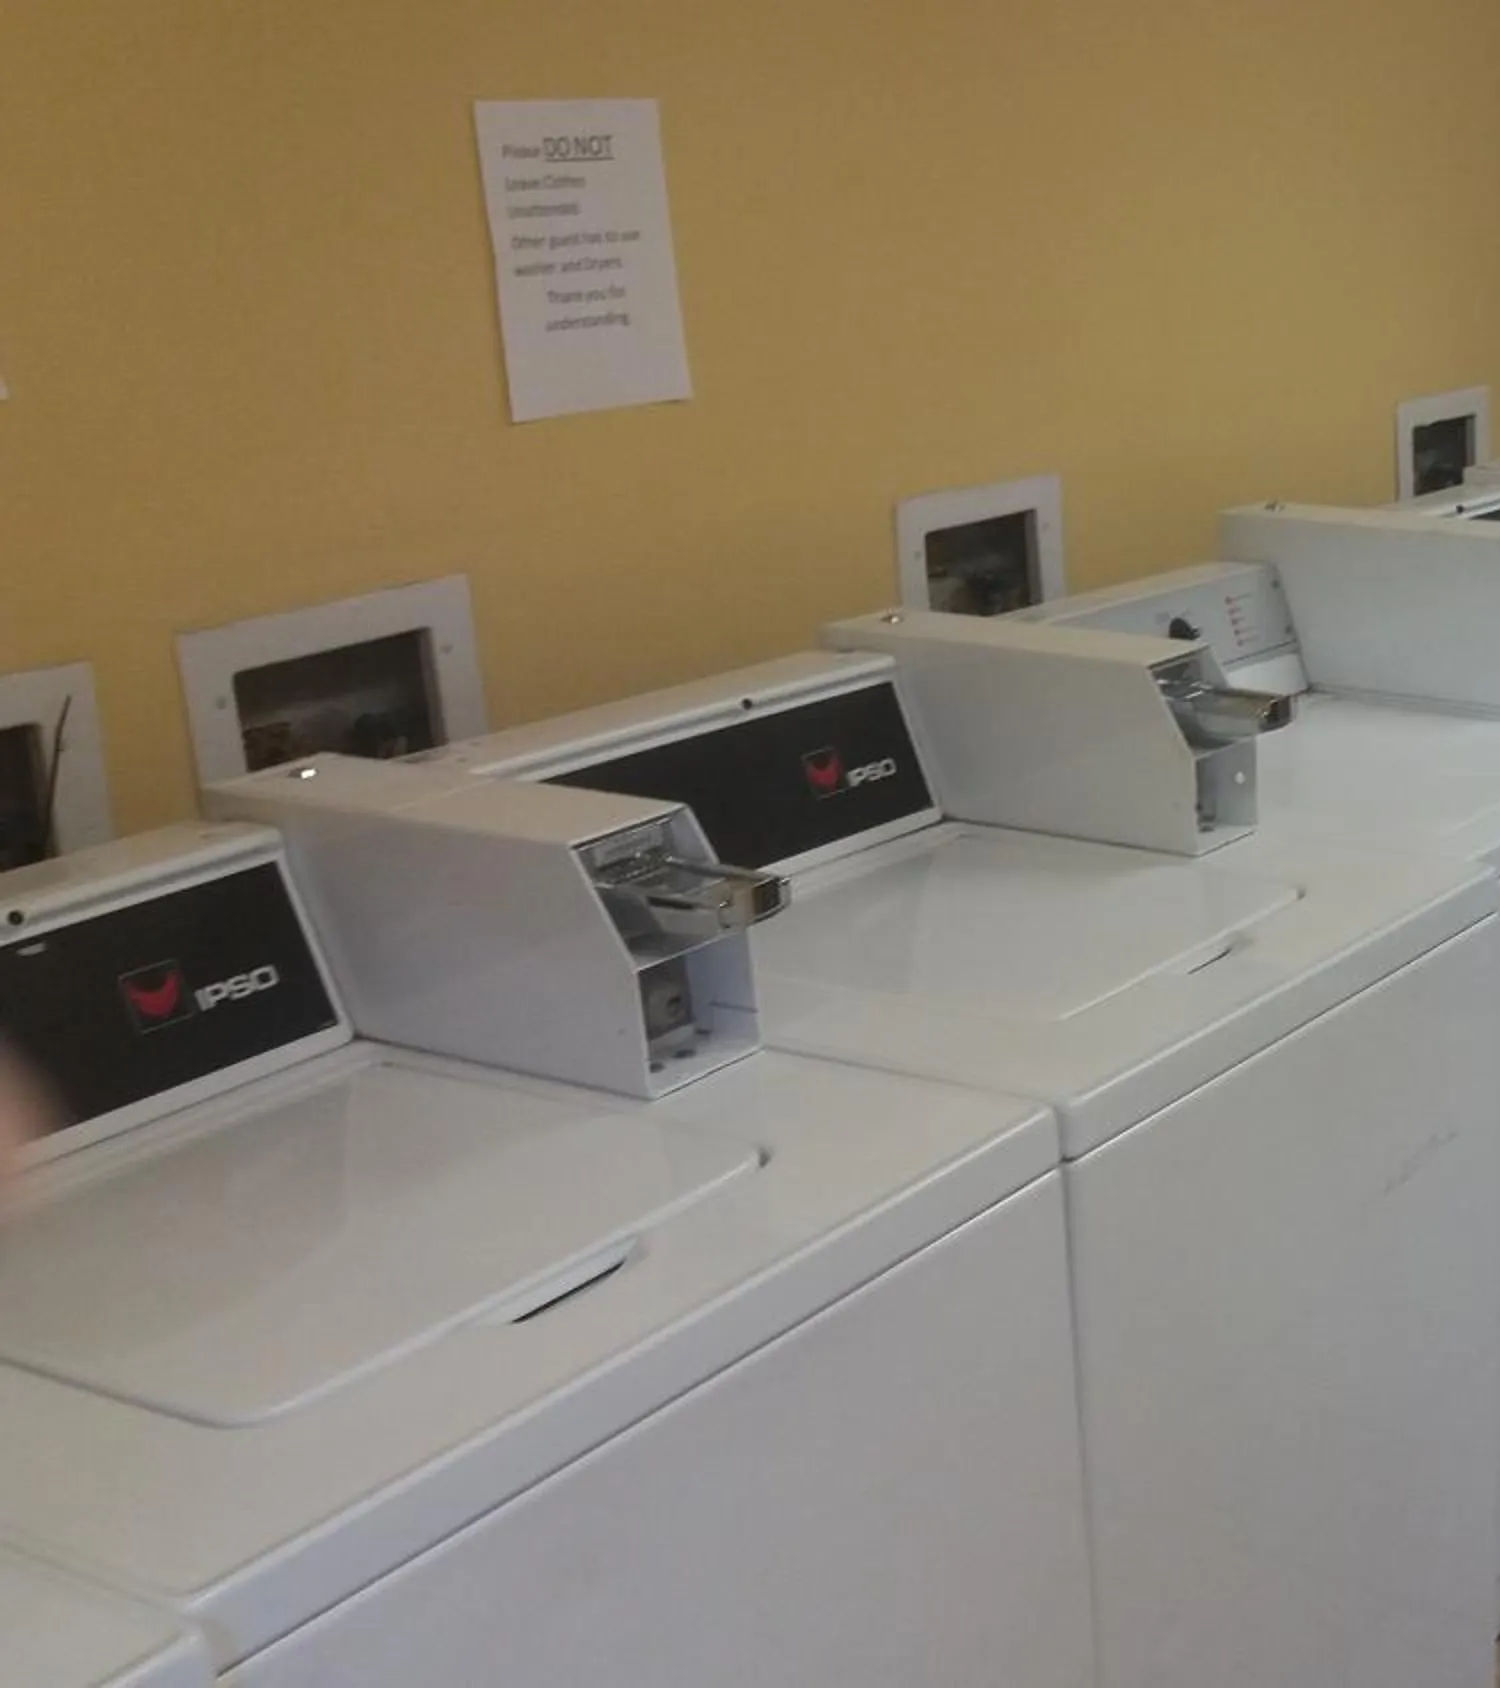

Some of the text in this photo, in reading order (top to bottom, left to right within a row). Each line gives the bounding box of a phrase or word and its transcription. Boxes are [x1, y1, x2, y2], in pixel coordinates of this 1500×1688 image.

[543, 137, 570, 157] DO
[574, 135, 613, 157] NOT
[847, 757, 897, 787] IPSO
[194, 964, 280, 1011] IPSO
